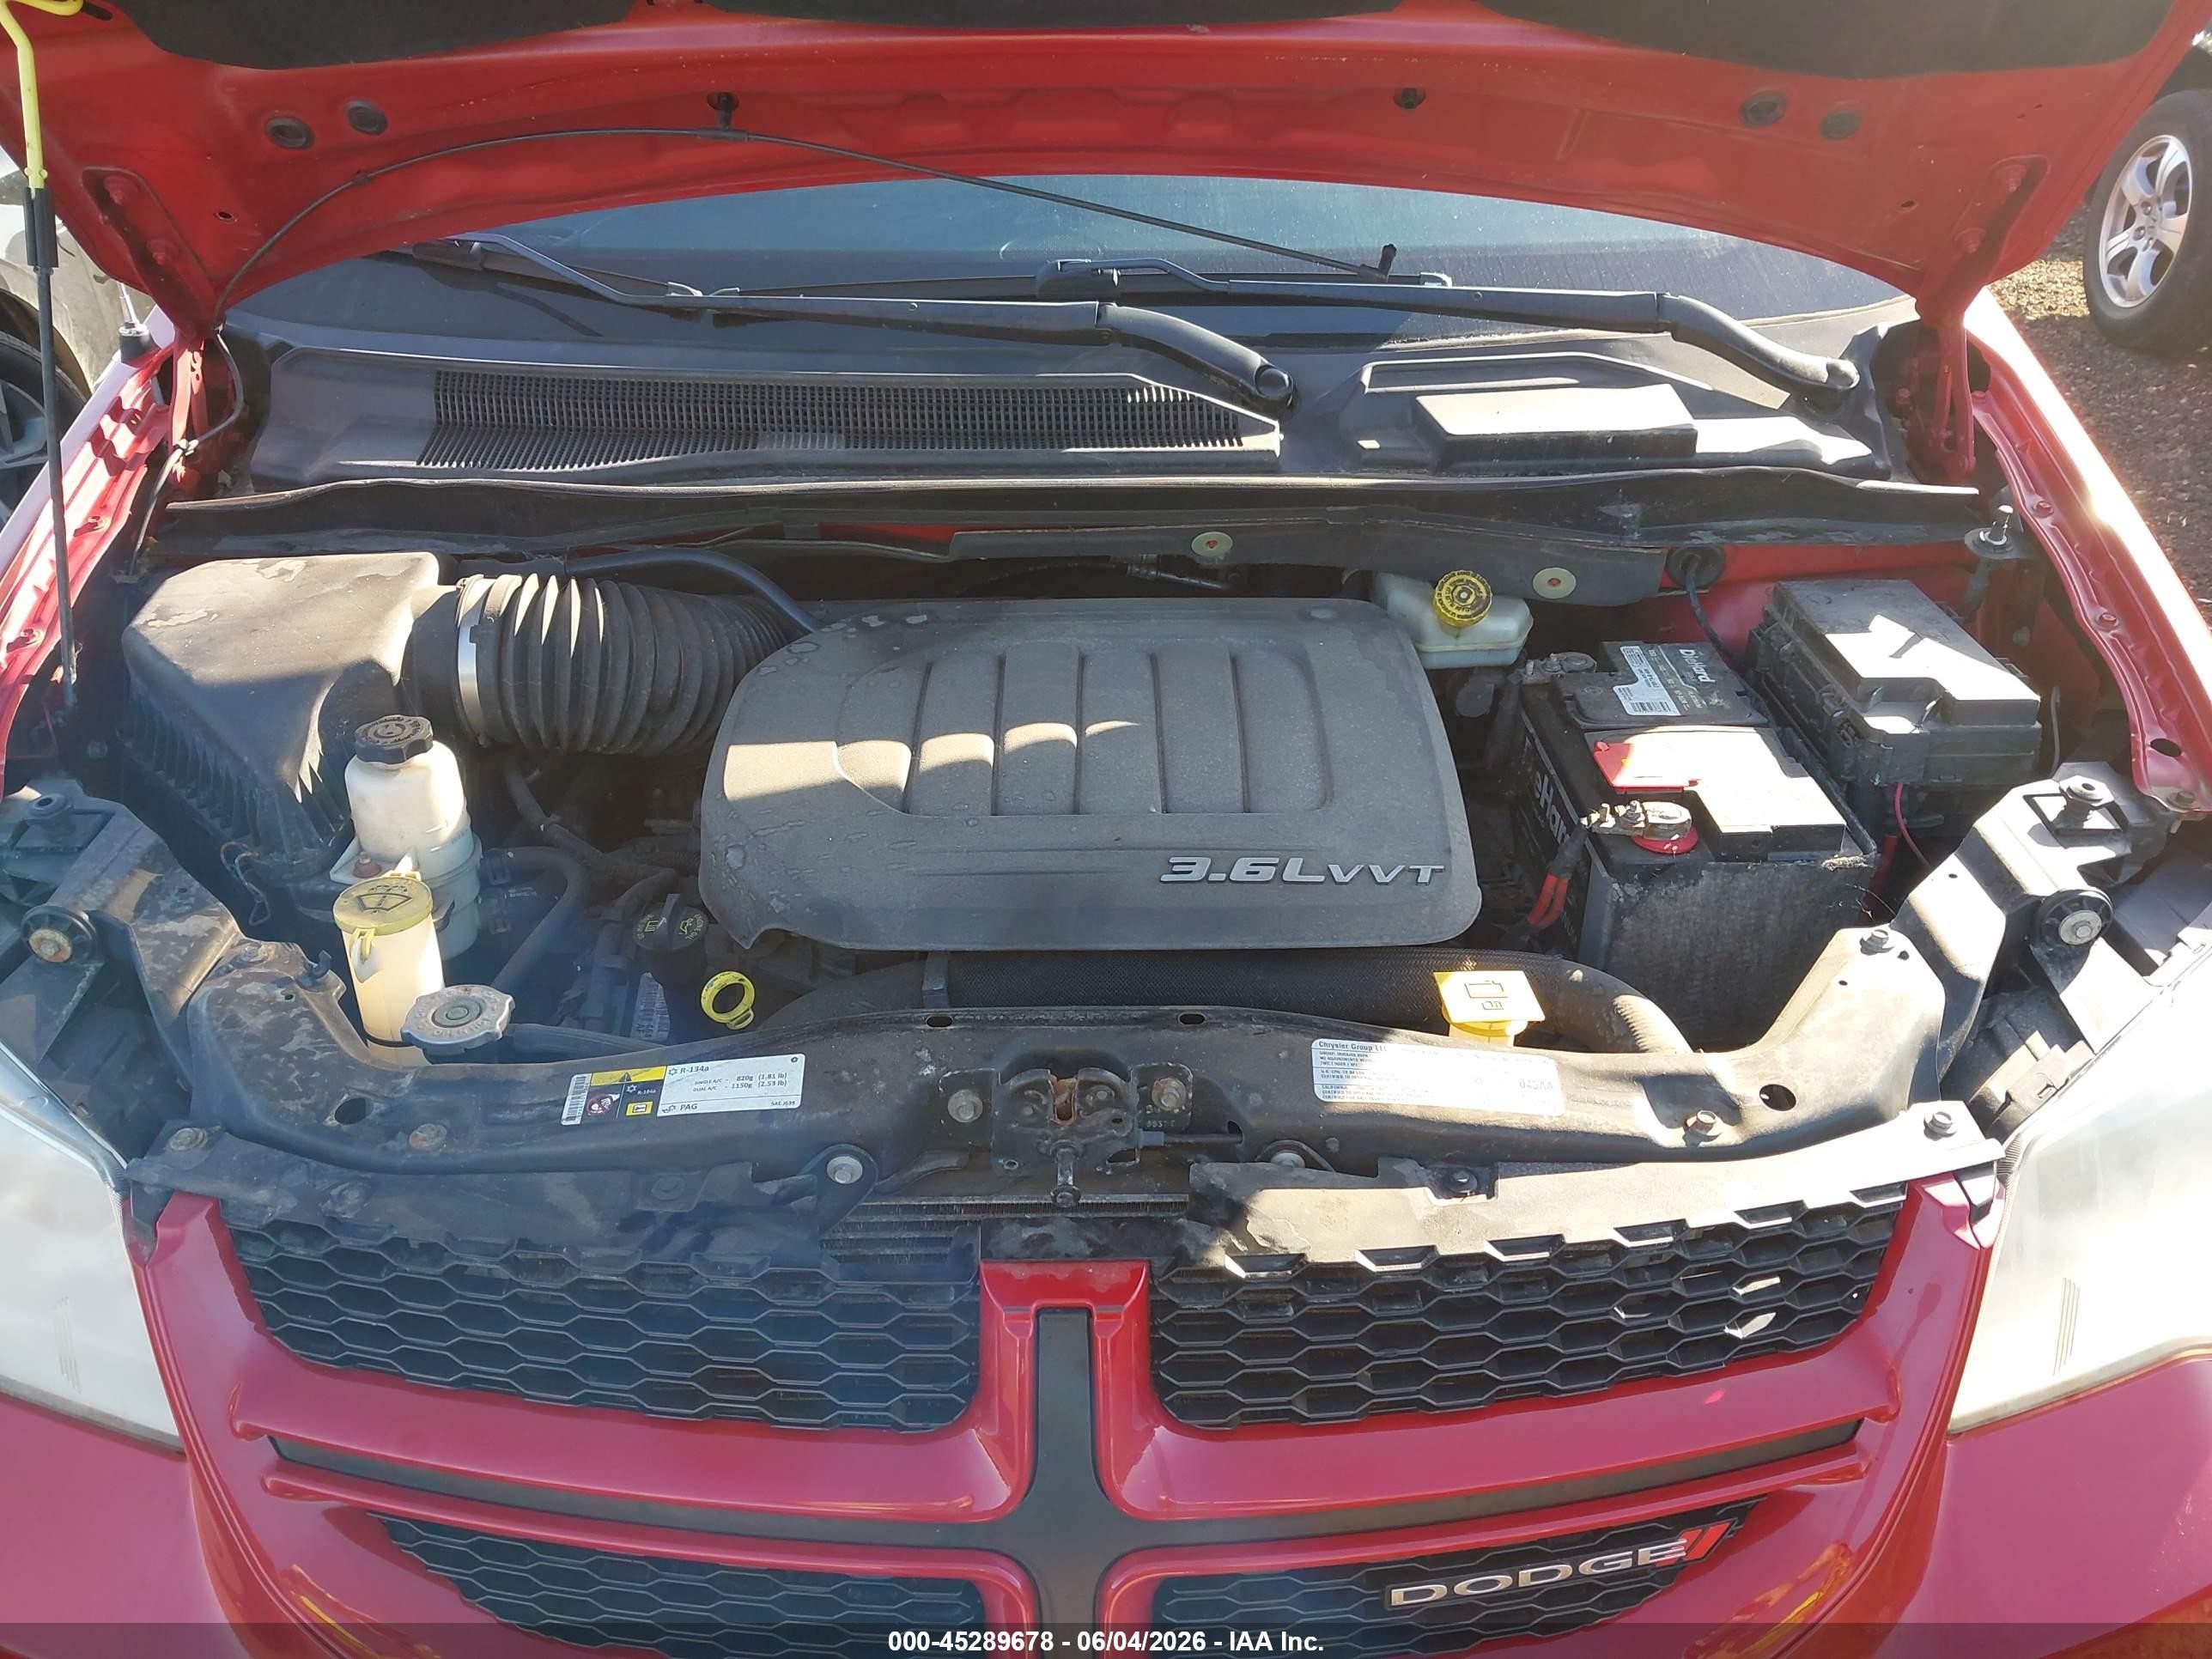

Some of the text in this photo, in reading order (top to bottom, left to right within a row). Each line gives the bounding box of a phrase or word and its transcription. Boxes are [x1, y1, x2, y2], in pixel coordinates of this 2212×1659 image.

[1679, 648, 1716, 683] DieHard
[1351, 1043, 1373, 1052] Group
[679, 1065, 710, 1074] R-134a
[757, 1073, 776, 1081] (1.81
[777, 1072, 787, 1080] lb)
[757, 1080, 776, 1089] (2.53
[777, 1079, 787, 1088] lb)
[679, 1103, 698, 1111] PAG
[1391, 1537, 1688, 1607] DODGE
